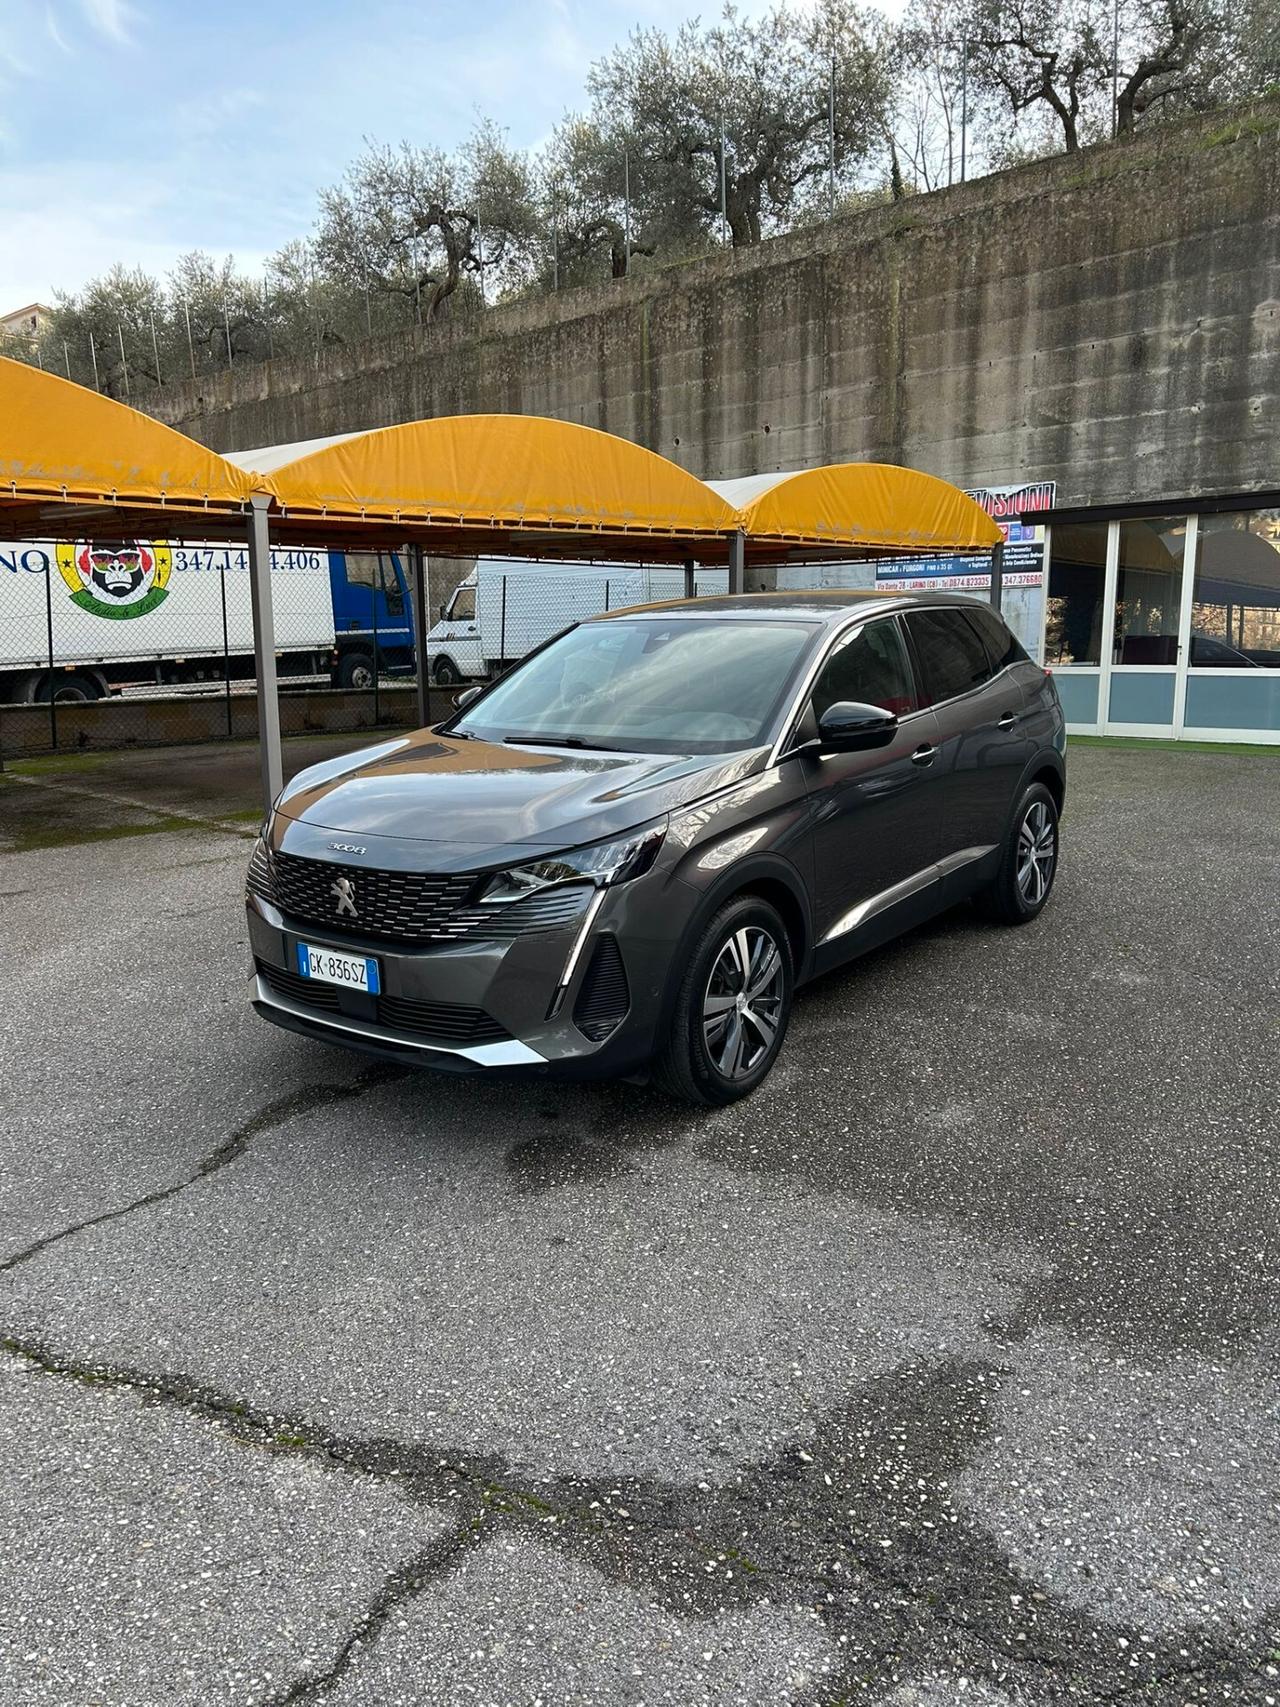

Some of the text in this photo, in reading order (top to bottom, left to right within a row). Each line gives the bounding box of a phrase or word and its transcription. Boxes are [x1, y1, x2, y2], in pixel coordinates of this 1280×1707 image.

[175, 551, 320, 571] 347.144.406
[902, 563, 925, 572] FURGONI
[327, 842, 367, 856] 3008
